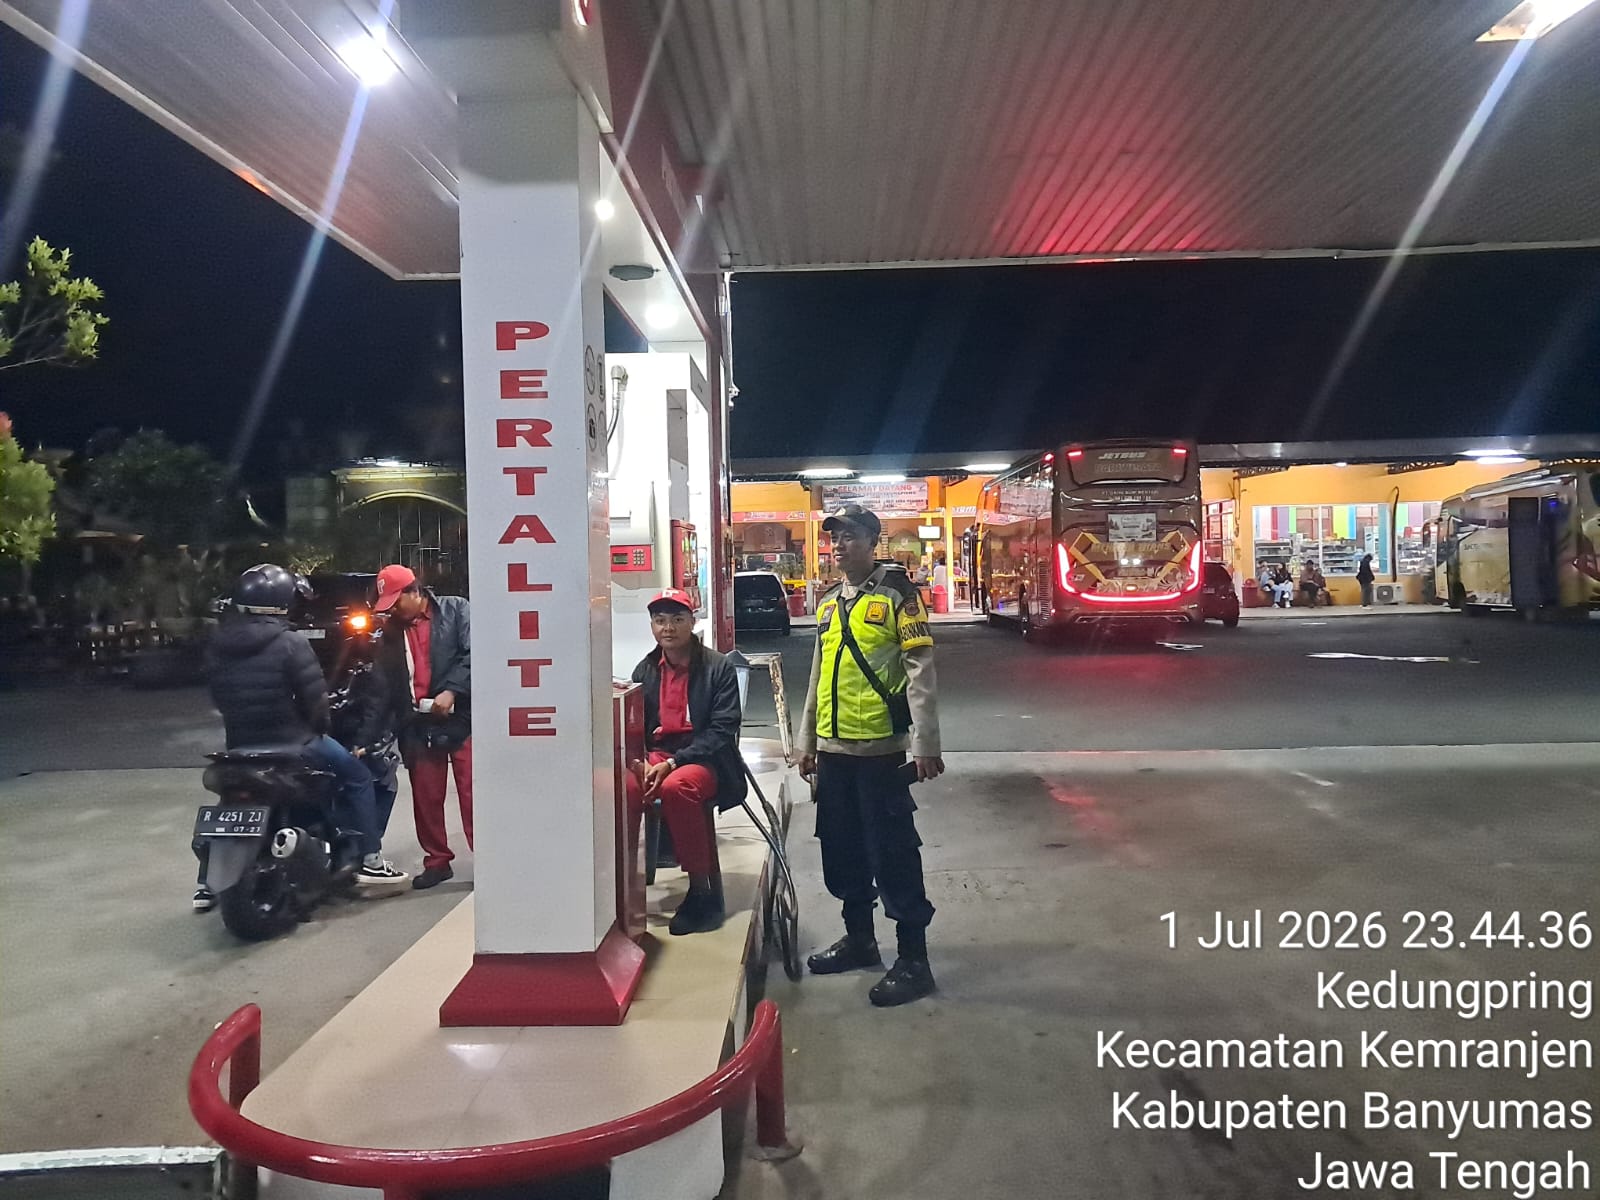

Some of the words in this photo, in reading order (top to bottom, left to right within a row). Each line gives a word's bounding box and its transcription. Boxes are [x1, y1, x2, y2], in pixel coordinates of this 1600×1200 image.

[879, 483, 912, 492] DATANG
[495, 321, 557, 737] PERTALITE
[204, 811, 212, 821] R
[218, 811, 243, 822] 4251
[248, 811, 262, 822] ZJ
